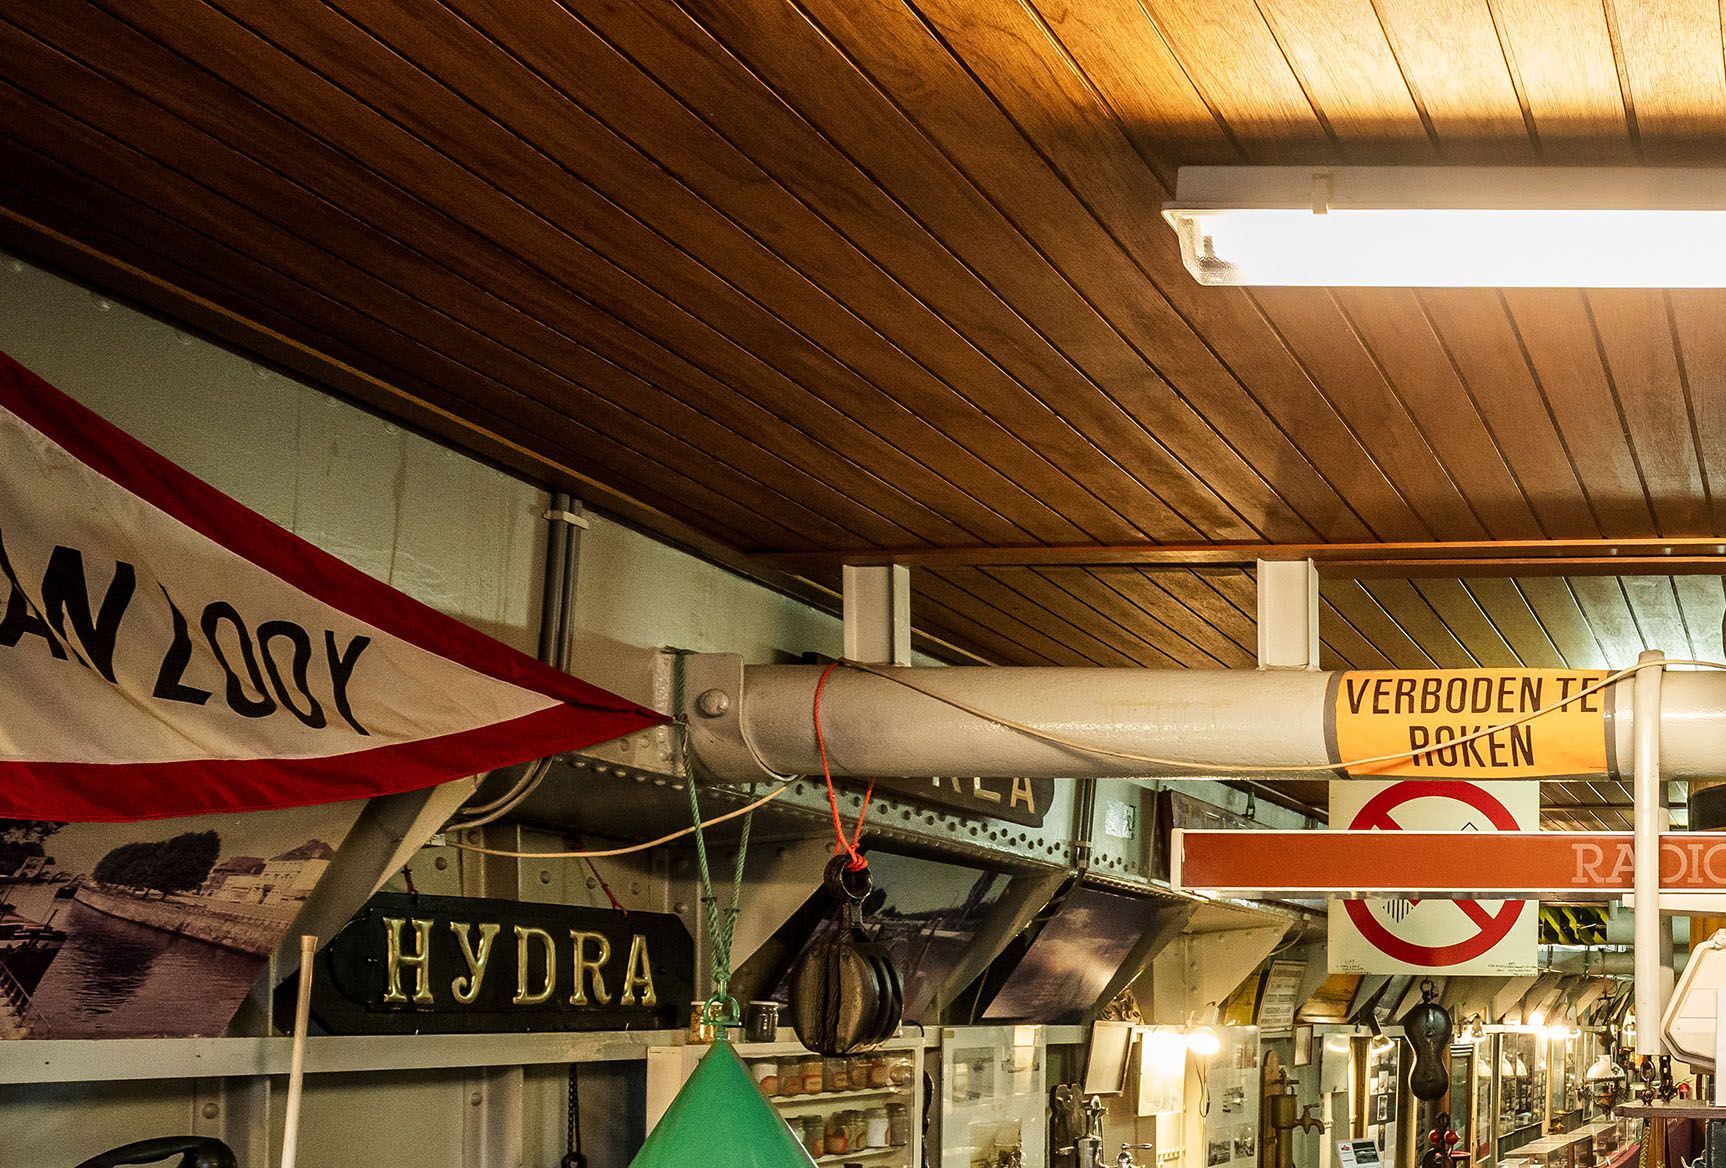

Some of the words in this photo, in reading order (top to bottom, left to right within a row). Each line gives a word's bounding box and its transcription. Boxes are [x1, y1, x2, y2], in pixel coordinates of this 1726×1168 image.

[153, 580, 371, 737] LOOY
[1346, 677, 1543, 715] VERBODEN
[1556, 677, 1599, 713] TE
[1409, 724, 1535, 768] ROKEN
[382, 915, 657, 1007] HYDRA
